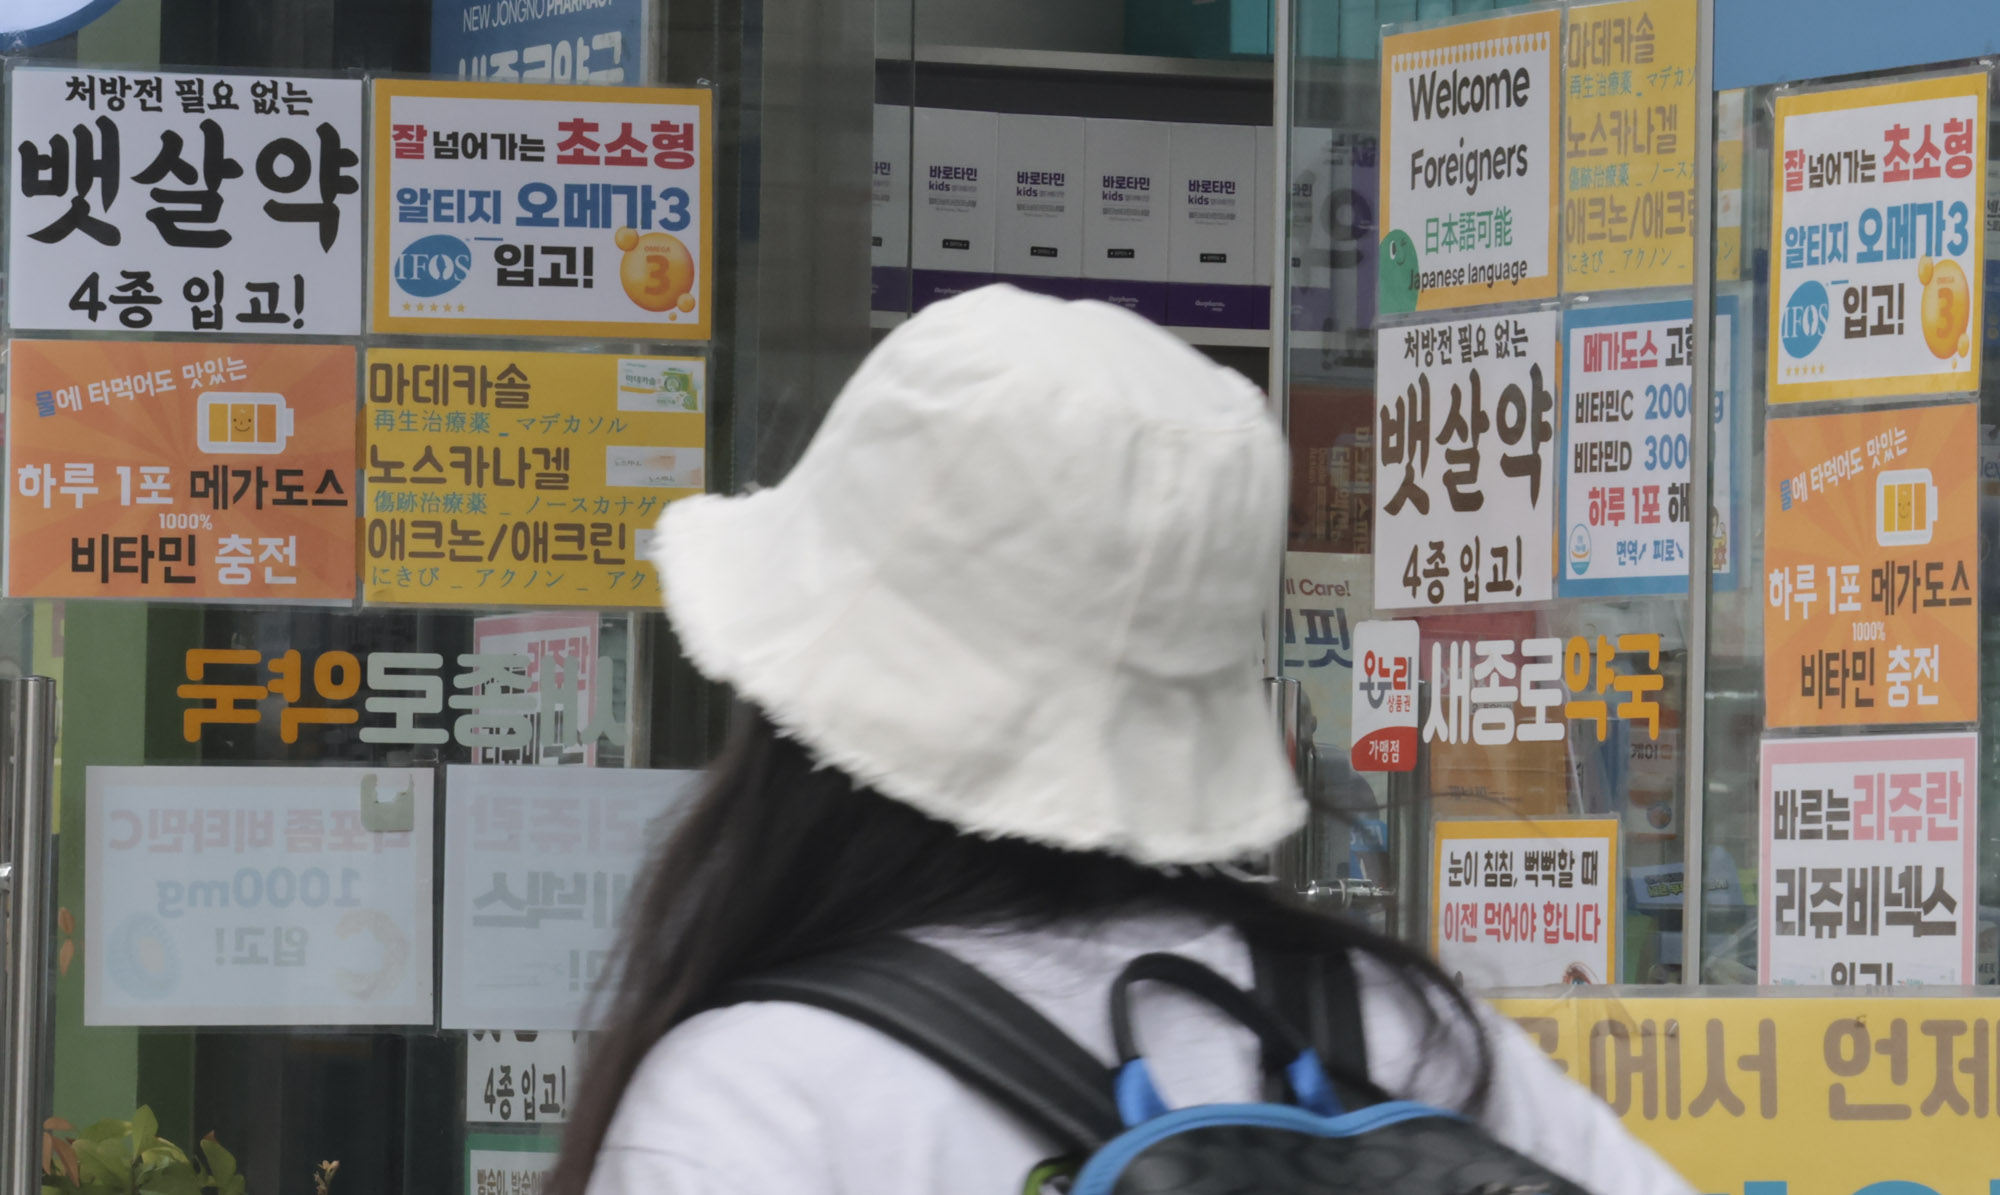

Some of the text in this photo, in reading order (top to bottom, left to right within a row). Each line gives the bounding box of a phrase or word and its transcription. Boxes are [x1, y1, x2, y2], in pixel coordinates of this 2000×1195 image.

[463, 5, 490, 33] NEW
[492, 0, 545, 28] JONGNO
[1569, 12, 1655, 68] 마데카솔
[66, 75, 313, 116] 처방전 필요 없는
[1410, 67, 1530, 122] Welcome
[392, 118, 695, 169] 잘 넘어가는 초소형
[1566, 104, 1678, 159] 노스카나겔
[929, 165, 978, 182] 바로타민
[1411, 137, 1528, 196] Foreigners
[1784, 117, 1973, 192] 잘 넘어가는 초소형
[18, 115, 359, 254] 뱃살약
[929, 181, 950, 192] kids
[1016, 171, 1065, 187] 바로타민
[1016, 186, 1038, 198] kids
[1102, 175, 1150, 191] 바로타민
[1102, 191, 1124, 202] kids
[1188, 179, 1236, 195] 바로타민
[1188, 195, 1210, 206] kids
[396, 182, 691, 231] 알티지 오메가3
[1425, 206, 1512, 256] 日本語可能
[1785, 221, 1848, 270] 알티지
[1856, 200, 1969, 264] 오메가3
[397, 253, 469, 281] IFOS
[494, 244, 593, 288] 입고!
[1408, 258, 1528, 293] Japanese language
[69, 269, 304, 331] 4종 입고!
[1782, 303, 1829, 339] IFOS
[1843, 283, 1905, 339] 입고!
[1404, 319, 1529, 368] 처방전 필요 없는
[1583, 330, 1658, 373] 메가도스
[35, 357, 247, 417] 물에 타먹어도 맛있는
[370, 363, 531, 409] 마데카솔
[1575, 389, 1634, 424] 비타민C
[374, 410, 491, 434] 再生治療薬
[517, 414, 628, 434] マデカソル
[1380, 362, 1554, 516] 뱃살약
[368, 445, 570, 490] 노스카나겔
[1574, 433, 1691, 474] 비타민D 300
[1780, 426, 1907, 512] 물에 타먹어도 맛있는
[17, 463, 348, 510] 하루 1포 메가도스
[374, 492, 487, 515] 傷跡治療薬
[1588, 486, 1625, 527] 하루
[1632, 484, 1661, 525] 1포
[159, 514, 212, 530] 1000%
[368, 518, 625, 565] 애크논/애크린
[71, 534, 297, 585] 비타민 충전
[1402, 535, 1523, 605] 4종 입고!
[1617, 539, 1676, 566] 면역 피로
[372, 566, 439, 587] にきび
[476, 568, 564, 589] アクノン
[1299, 577, 1352, 597] Care!
[1768, 560, 1972, 621] 하루 1포 메가도스
[1852, 621, 1886, 641] 1000%
[1422, 632, 1664, 746] 새종로약국
[1801, 644, 1939, 709] 비타민 충전
[1387, 695, 1411, 713] 상품권
[1369, 739, 1400, 764] 가맹점
[1774, 770, 1962, 843] 바르는 리쥬란
[1448, 851, 1478, 888] 눈이
[1484, 850, 1518, 888] 침침,
[1524, 848, 1575, 888] 뻑뻑할
[1581, 850, 1600, 887] 때
[1444, 900, 1601, 944] 이젠 먹어야 합니다
[1775, 865, 1957, 939] 리쥬비넥스
[484, 1065, 514, 1120] 4종
